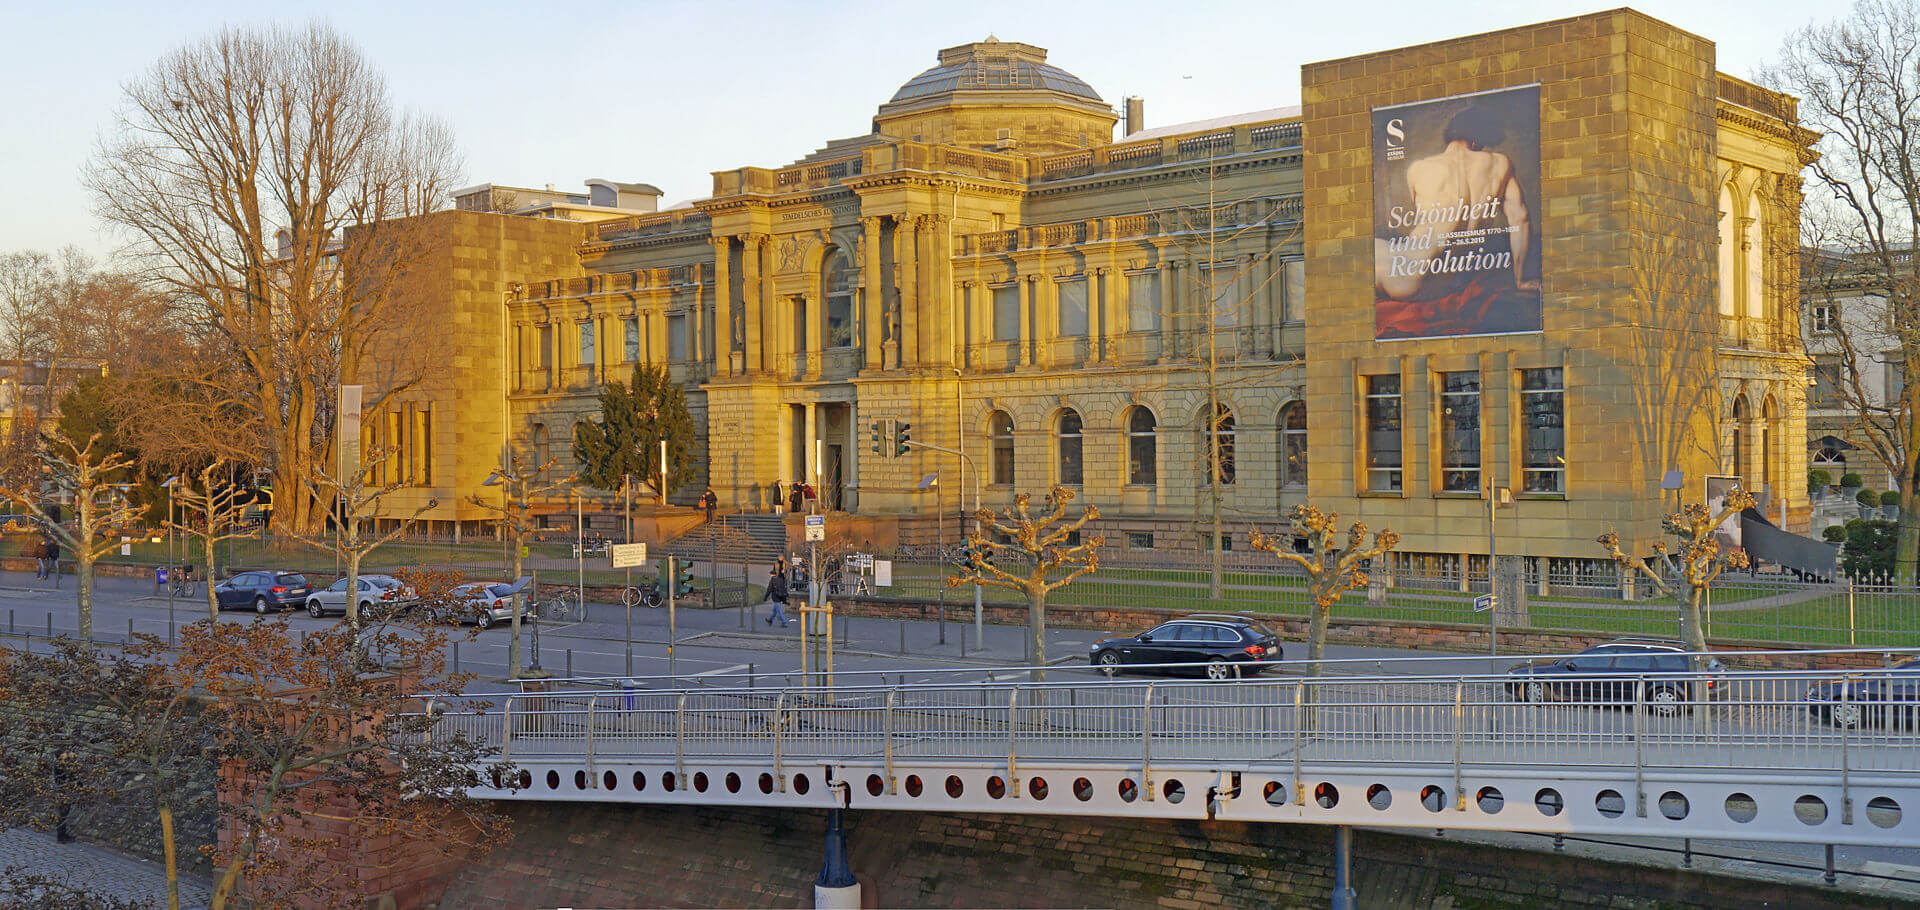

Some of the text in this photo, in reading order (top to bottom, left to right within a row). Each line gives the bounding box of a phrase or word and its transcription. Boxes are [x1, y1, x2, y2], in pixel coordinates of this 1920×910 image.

[1386, 119, 1405, 147] S
[1388, 195, 1500, 228] Schönheit
[1389, 227, 1432, 251] und
[1390, 247, 1511, 277] Revolution
